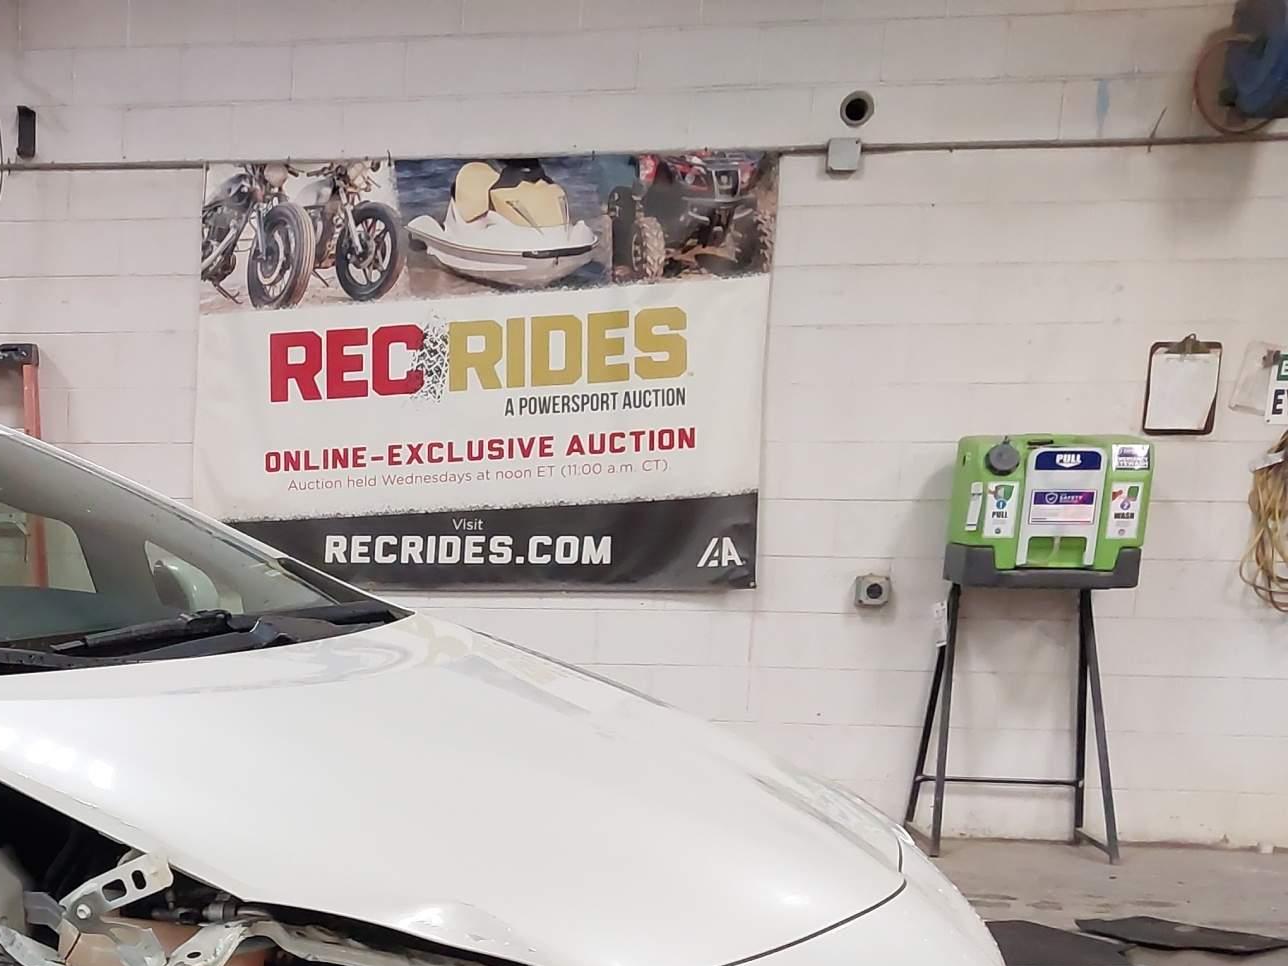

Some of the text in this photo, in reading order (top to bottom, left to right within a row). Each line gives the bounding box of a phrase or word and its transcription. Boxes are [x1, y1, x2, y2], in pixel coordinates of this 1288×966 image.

[269, 306, 688, 403] REC RIDES
[505, 387, 686, 417] A POWERSPORT AUCTION
[1272, 389, 1288, 415] E
[265, 427, 696, 474] ONLINE-EXCLUSIVE AUCTION
[1056, 453, 1082, 464] PULL
[287, 477, 343, 491] Auction
[347, 475, 377, 488] held
[382, 470, 472, 487] Wednesdays
[476, 469, 491, 481] at
[495, 468, 532, 480] noon
[537, 465, 555, 478] ET
[560, 462, 602, 478] (11:00
[452, 517, 483, 532] Visit
[992, 511, 1008, 519] PULL
[324, 534, 612, 565] RECRIDES.COM
